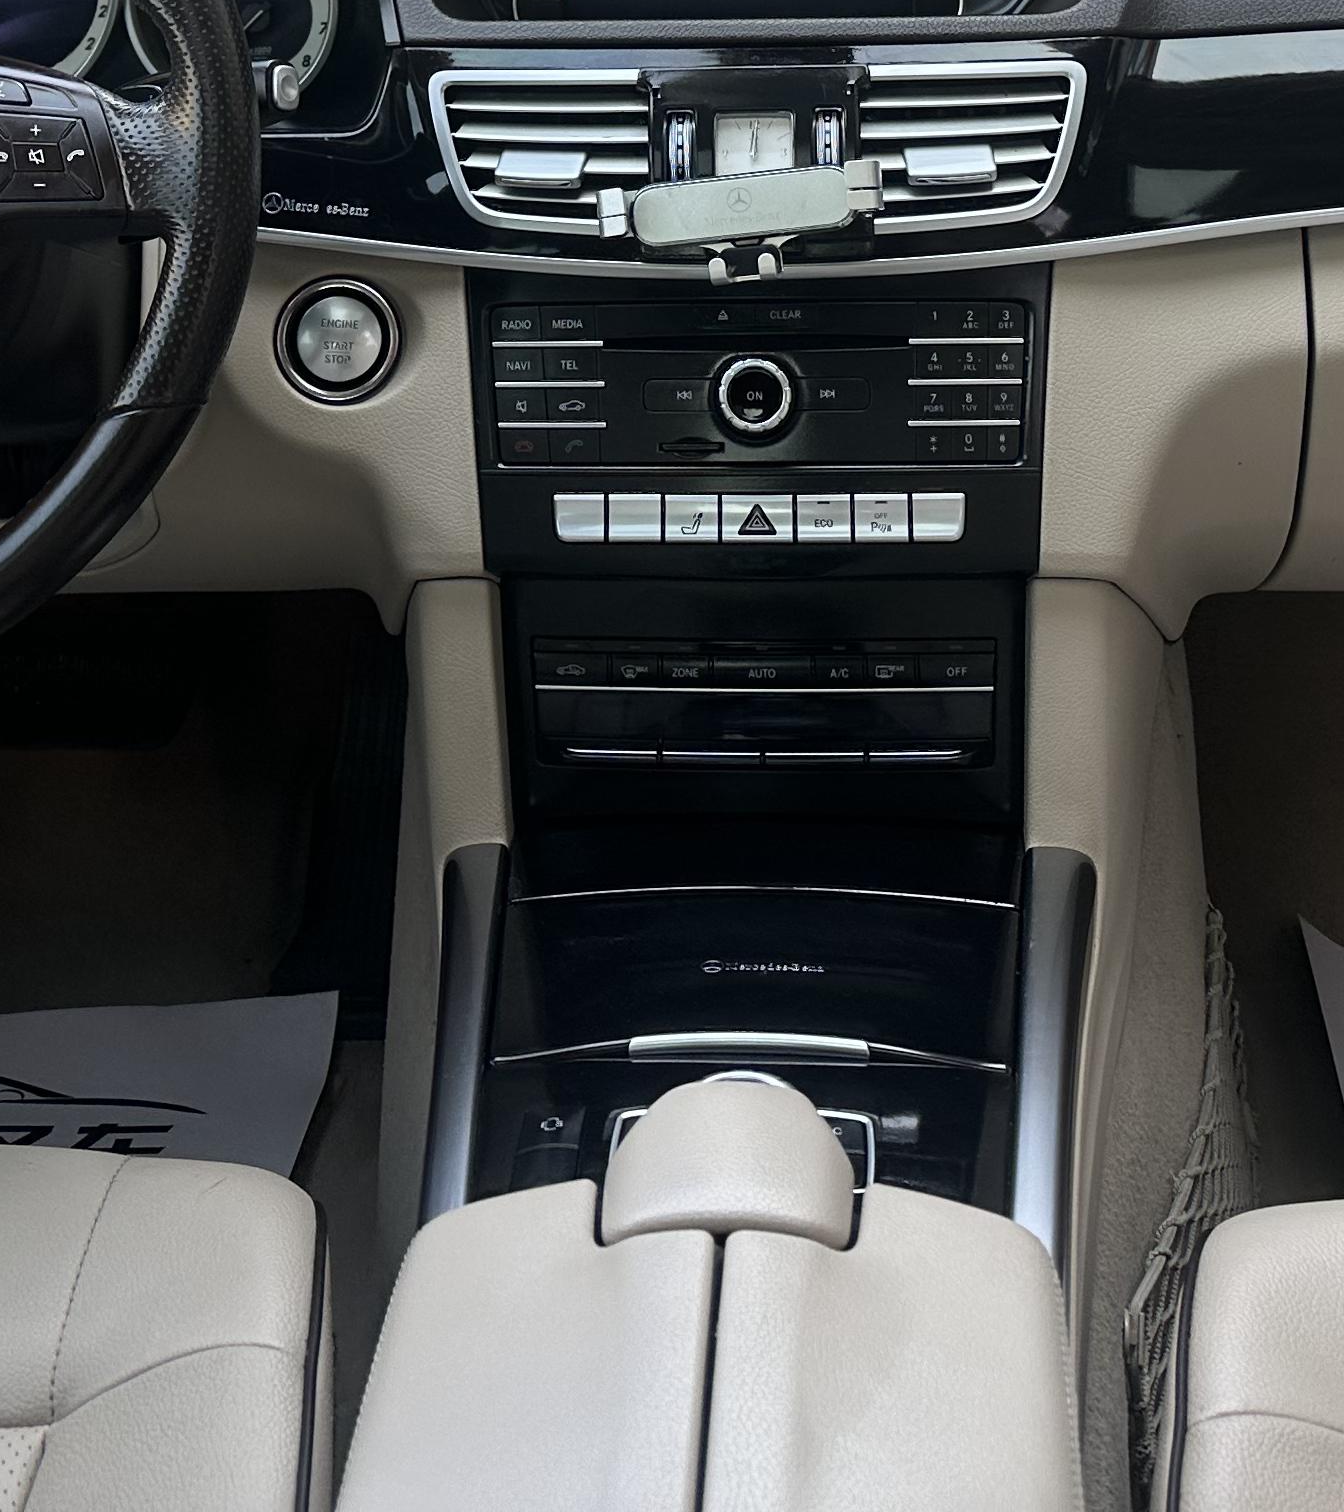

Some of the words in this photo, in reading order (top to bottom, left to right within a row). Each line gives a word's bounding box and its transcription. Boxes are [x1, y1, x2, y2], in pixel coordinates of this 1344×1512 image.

[319, 22, 328, 35] 7
[302, 55, 311, 67] 8
[769, 309, 802, 320] CLEAR
[932, 311, 938, 321] 1
[966, 310, 974, 321] 2
[1002, 310, 1010, 321] 3
[320, 318, 359, 330] ENGINE
[501, 319, 532, 330] RADIO
[552, 319, 584, 329] MEDIA
[323, 340, 353, 351] START
[324, 354, 352, 364] STOP
[930, 352, 938, 363] 4
[966, 352, 974, 363] 5
[1001, 352, 1009, 363] 6
[506, 360, 531, 371] NAVI
[560, 359, 578, 370] TEL
[746, 391, 763, 401] ON
[930, 393, 937, 404] 7
[965, 393, 973, 403] 8
[1000, 392, 1008, 403] 9
[964, 433, 973, 445] 0
[814, 519, 834, 528] ECO
[671, 667, 699, 678] ZONE
[748, 668, 777, 679] AUTO
[829, 668, 849, 678] A/C
[946, 666, 968, 677] OFF
